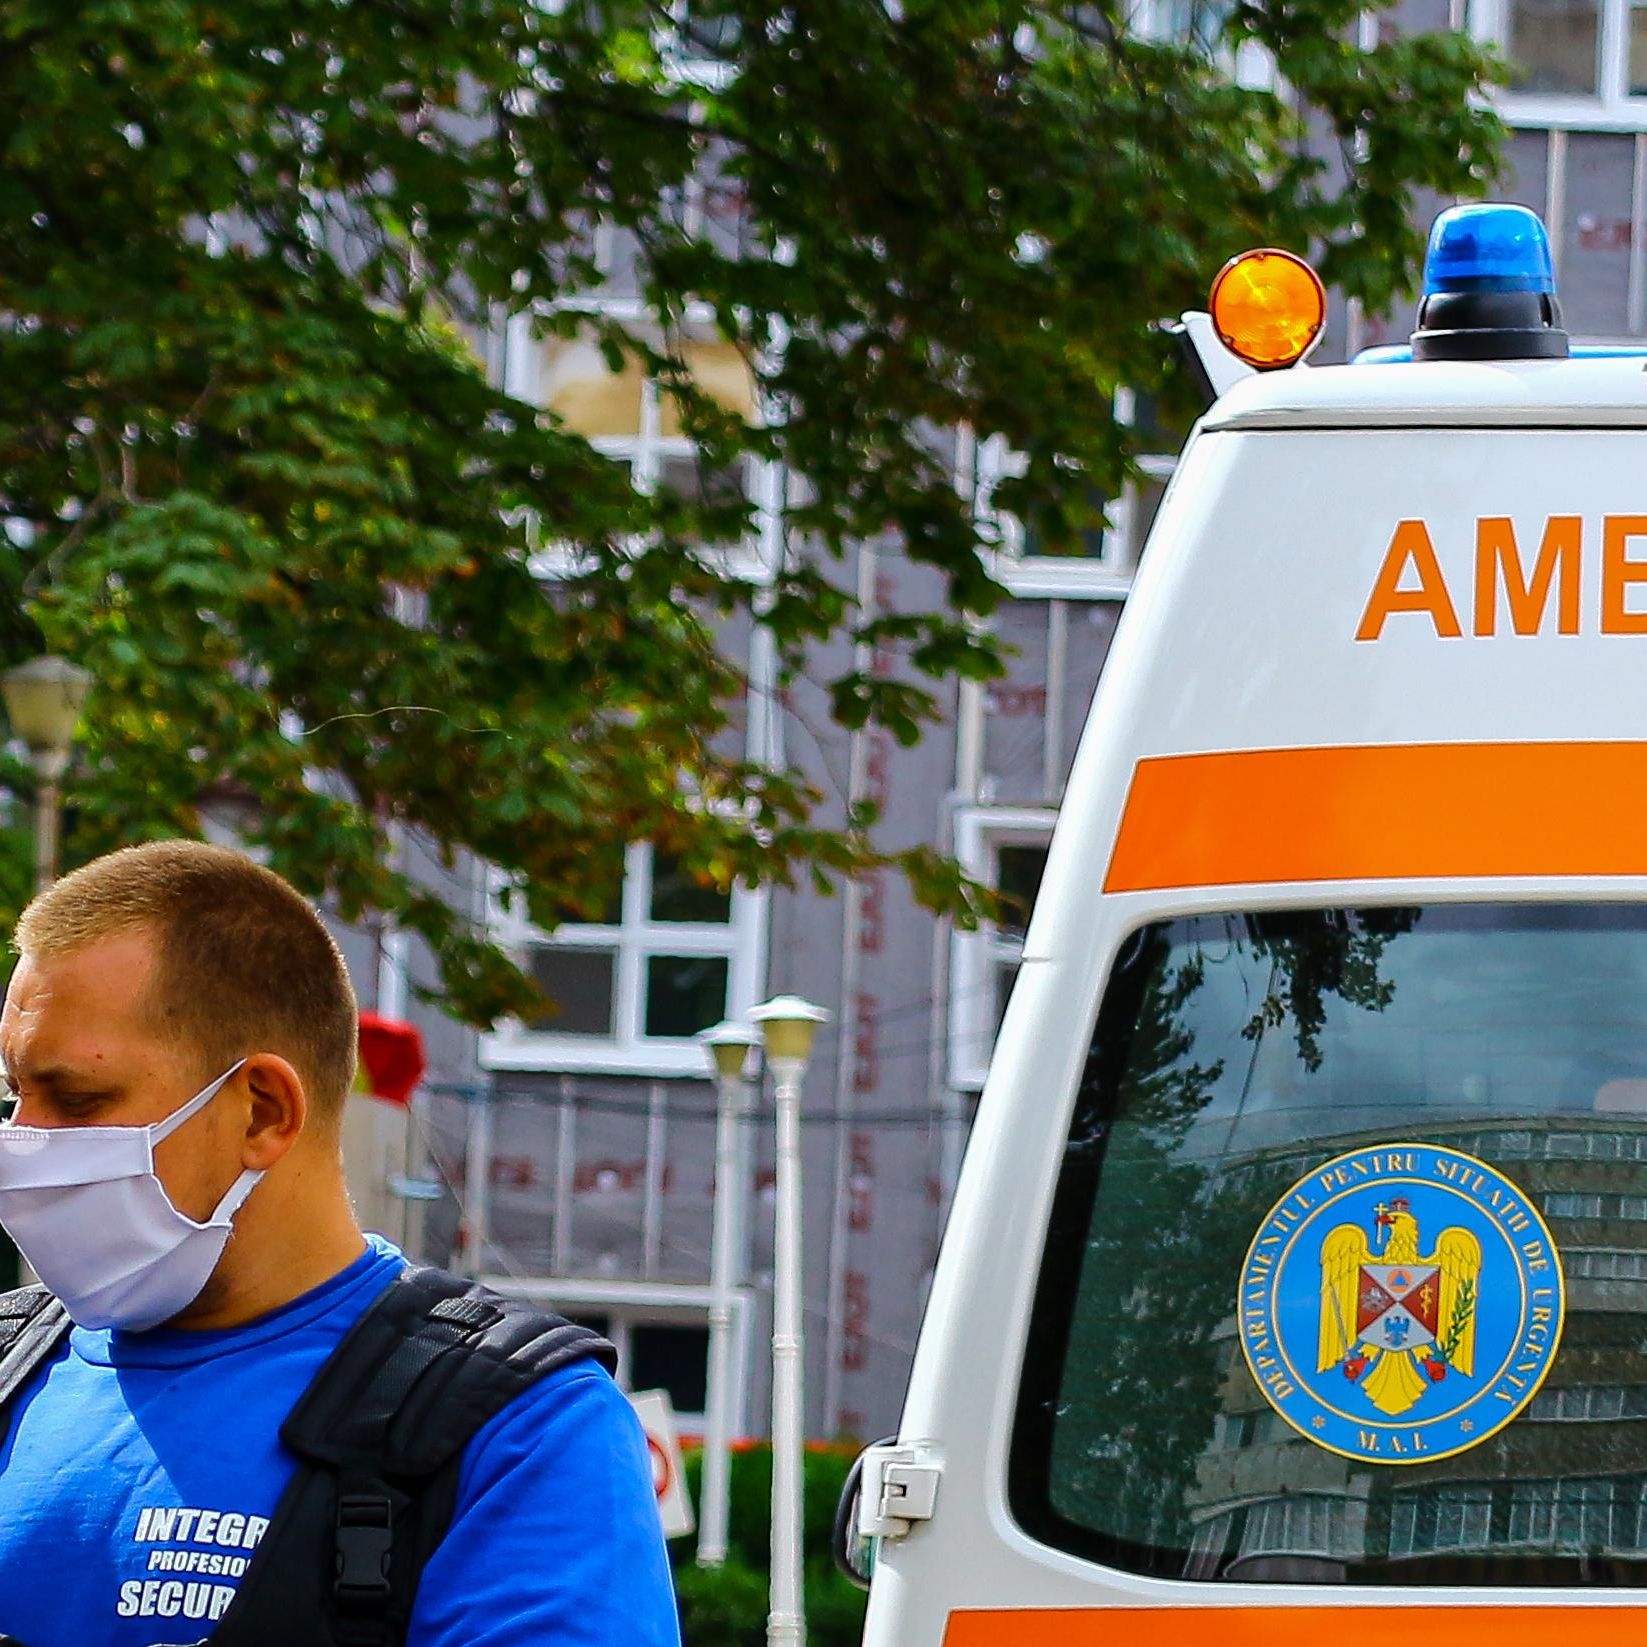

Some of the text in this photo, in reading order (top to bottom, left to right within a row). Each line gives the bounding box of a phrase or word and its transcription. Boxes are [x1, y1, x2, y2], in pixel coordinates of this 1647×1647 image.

[1246, 1195, 1316, 1400] DEPARTAMENTUL
[1319, 1152, 1422, 1193] PENTRU
[1522, 1239, 1550, 1276] DE
[133, 1507, 271, 1550] INTEGR
[147, 1550, 252, 1578] PROFESIO
[116, 1580, 237, 1621] SECUR
